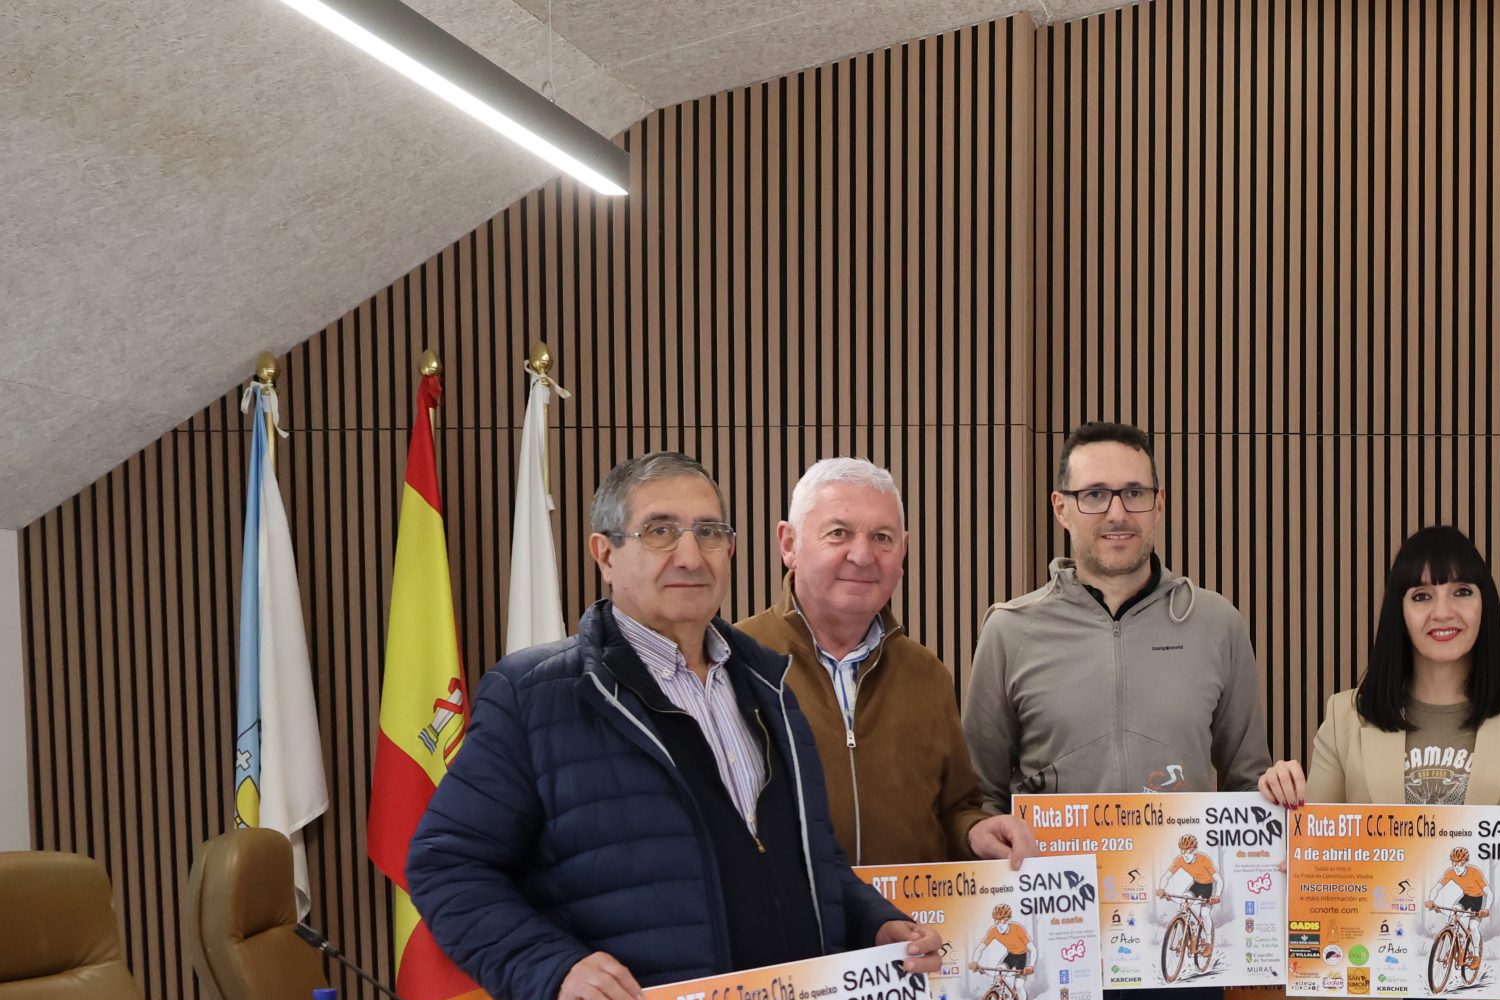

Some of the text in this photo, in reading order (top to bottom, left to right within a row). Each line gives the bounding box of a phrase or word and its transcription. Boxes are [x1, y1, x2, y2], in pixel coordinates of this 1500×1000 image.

[1033, 802, 1200, 828] Ruta BTT C.C. Terra Chá do queixo
[1205, 806, 1248, 824] SAN
[1294, 813, 1472, 838] X Ruta BTT C.C. Terra Chá do queixo
[1049, 838, 1133, 851] abril de 2026
[1206, 828, 1272, 846] SIMON
[1294, 847, 1405, 861] 4 de abril de 2026
[902, 874, 923, 898] C.C.
[925, 873, 952, 897] Terra
[955, 871, 975, 895] Chá
[979, 885, 988, 893] do
[990, 884, 1014, 894] queixo
[1018, 872, 1061, 891] SAN
[1019, 893, 1086, 915] SIMON
[911, 909, 945, 924] 2026
[842, 963, 891, 991] SAN
[798, 989, 809, 1000] do
[811, 984, 837, 999] queixo
